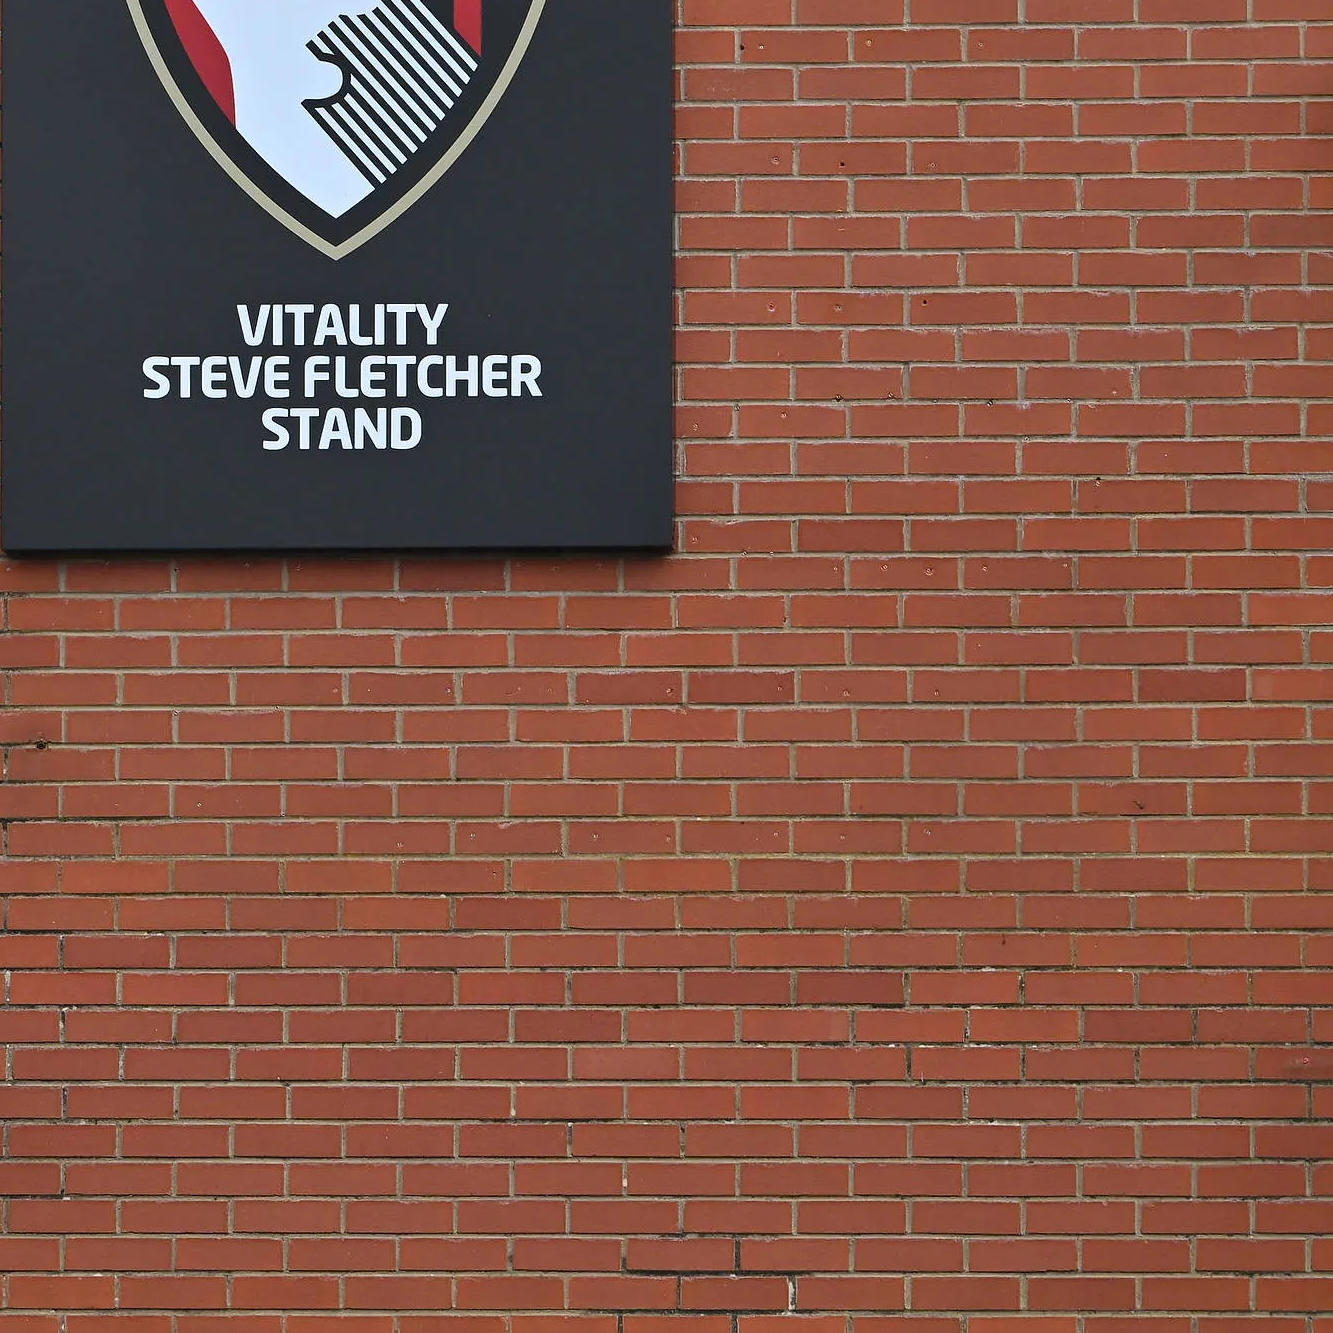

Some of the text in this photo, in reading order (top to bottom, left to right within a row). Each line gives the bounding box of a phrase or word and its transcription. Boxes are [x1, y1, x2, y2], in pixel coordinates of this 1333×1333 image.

[236, 303, 449, 347] VITALITY
[142, 354, 543, 399] STEVE FLETCHER
[261, 406, 422, 451] STAND
